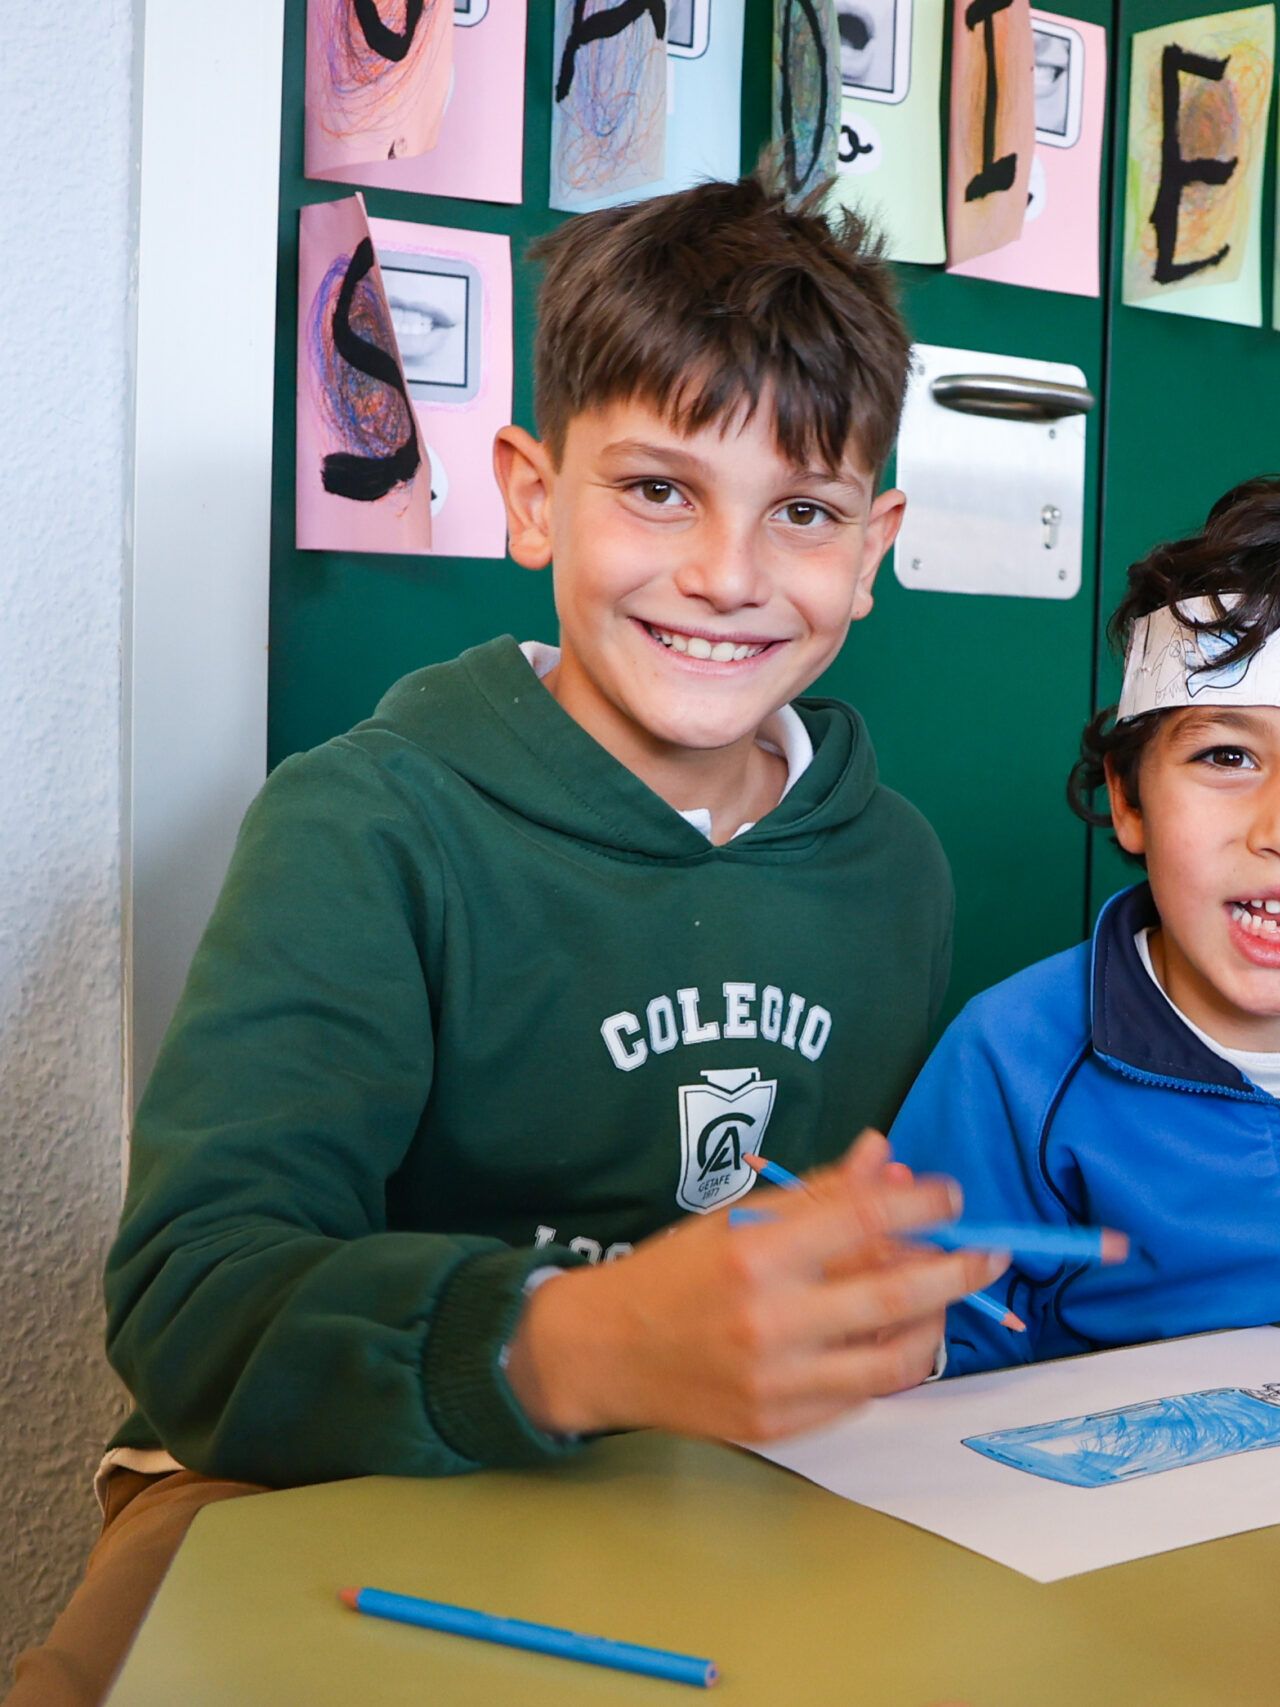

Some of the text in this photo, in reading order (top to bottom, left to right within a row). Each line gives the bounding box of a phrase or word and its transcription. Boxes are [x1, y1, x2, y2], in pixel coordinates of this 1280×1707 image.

[1150, 43, 1238, 285] E
[320, 237, 421, 501] S
[600, 982, 833, 1072] COLEGIO
[698, 1174, 731, 1192] GETAFE
